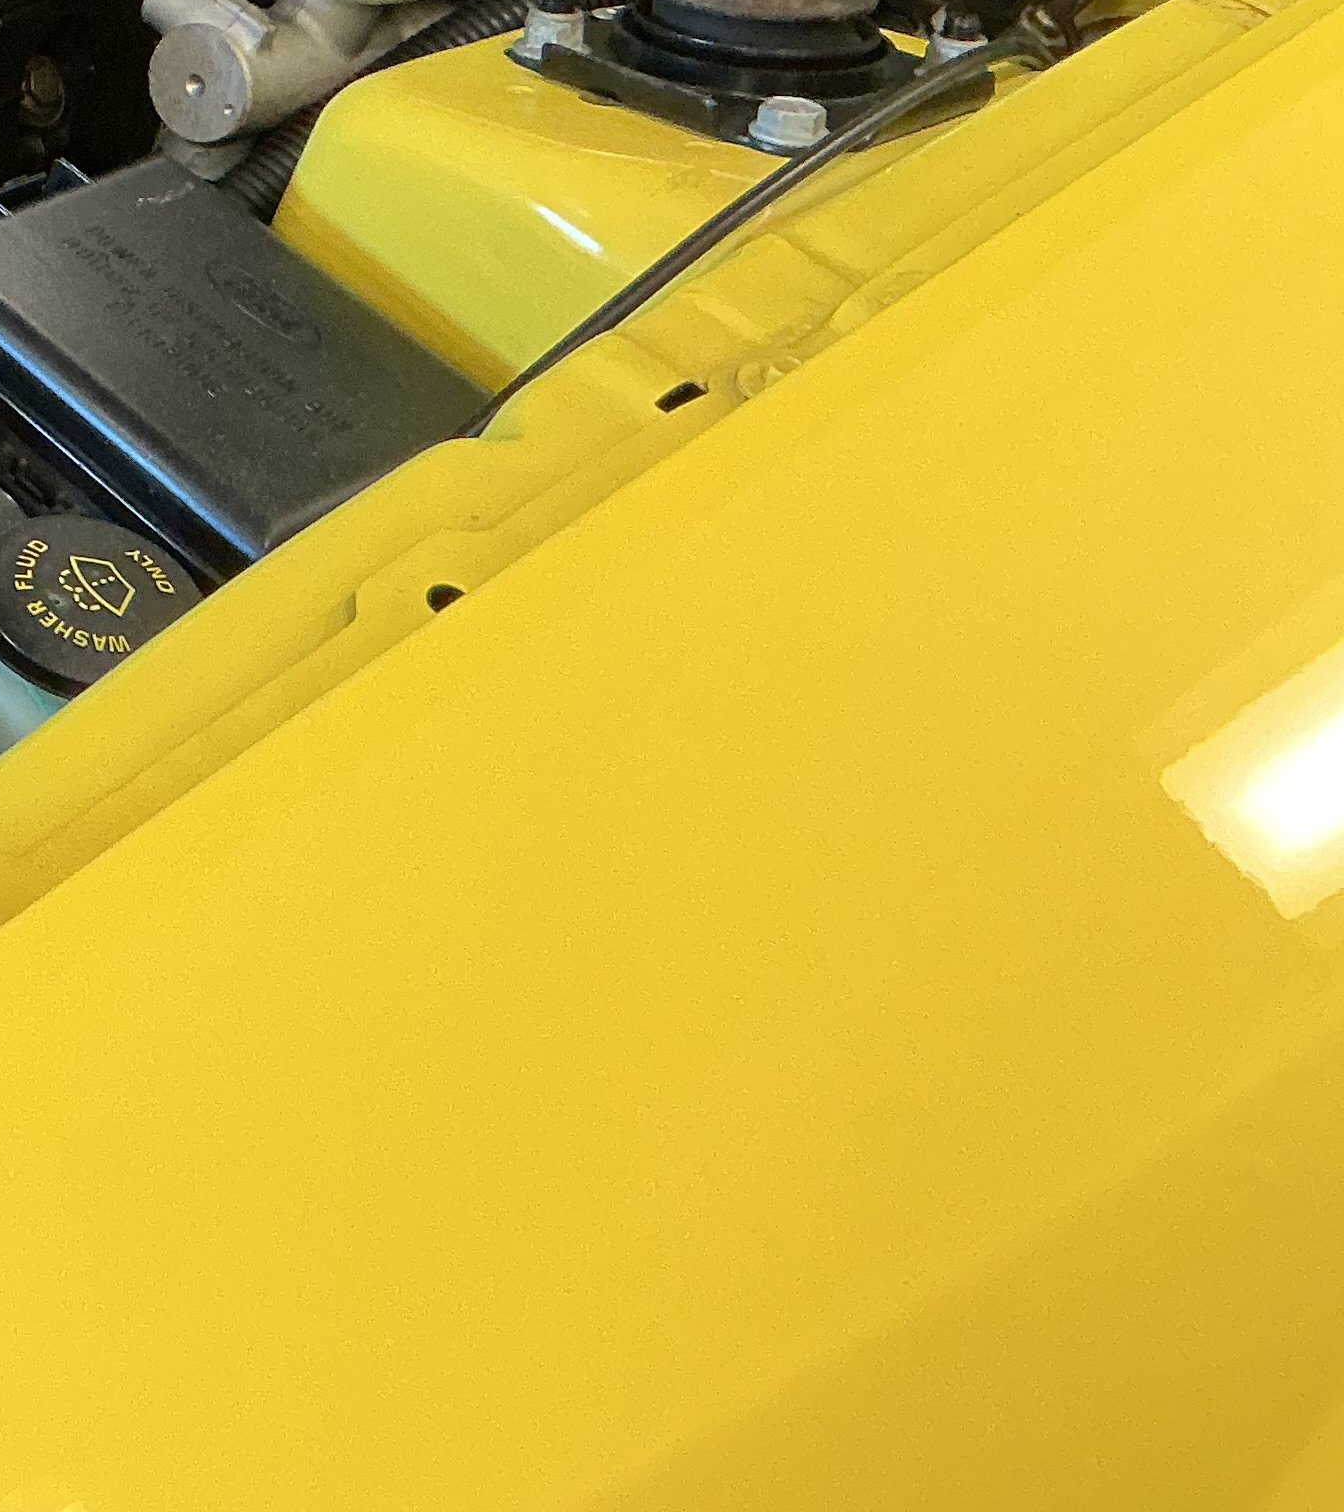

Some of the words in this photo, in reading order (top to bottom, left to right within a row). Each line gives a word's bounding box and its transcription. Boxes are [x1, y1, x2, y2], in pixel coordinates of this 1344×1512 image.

[13, 538, 49, 592] FLUID
[124, 548, 177, 595] ONLY
[26, 598, 131, 653] WASHER
